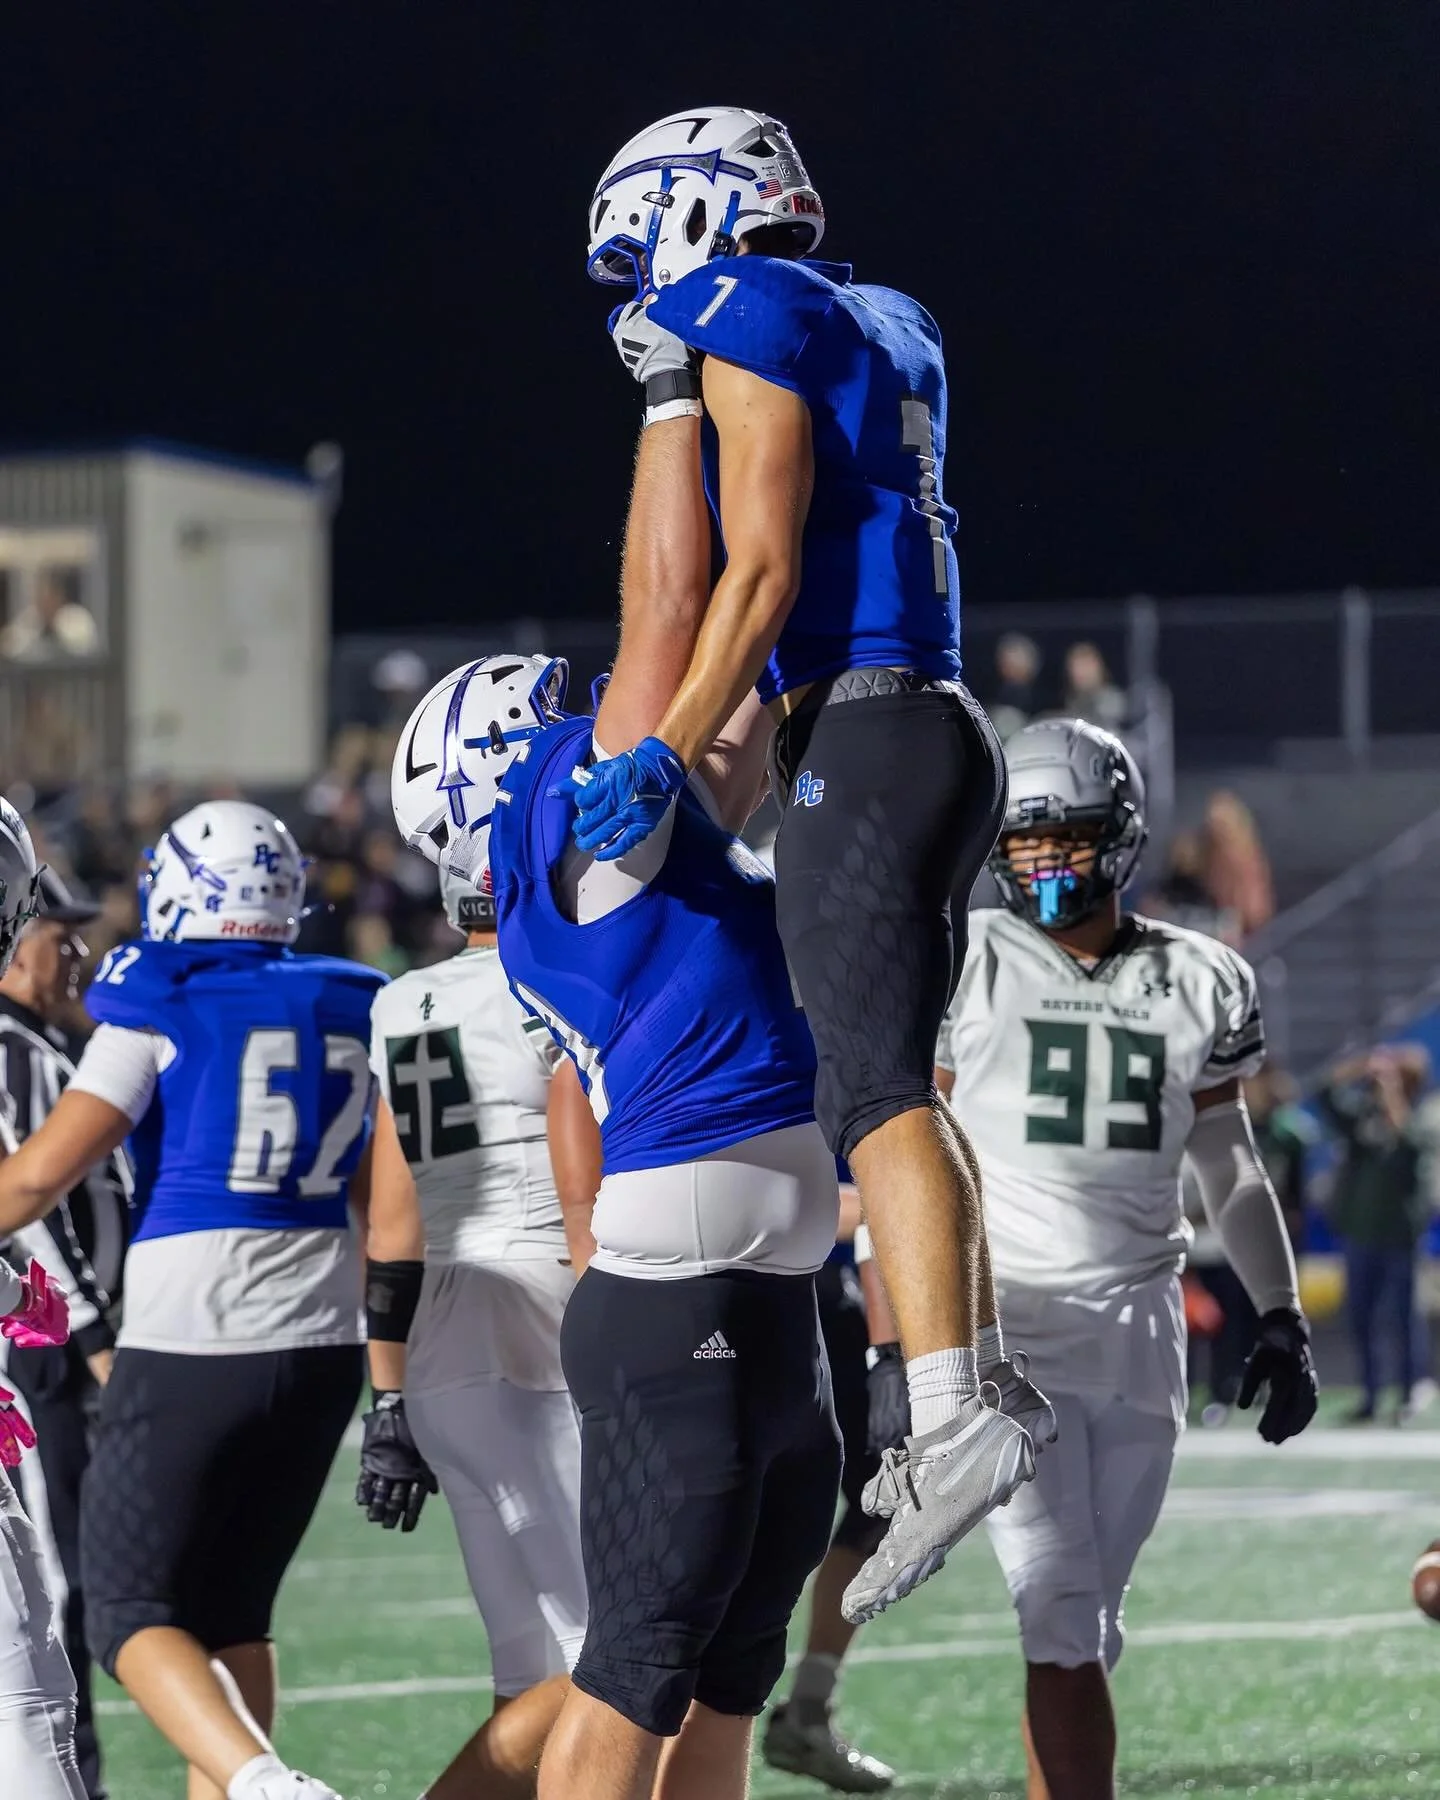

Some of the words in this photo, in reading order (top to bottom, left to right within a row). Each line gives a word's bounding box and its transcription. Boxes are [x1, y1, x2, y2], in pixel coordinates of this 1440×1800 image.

[694, 275, 738, 327] 7
[793, 770, 824, 807] BC
[460, 902, 495, 916] VICI
[1025, 1018, 1167, 1153] 99
[227, 1027, 371, 1196] 62
[693, 1347, 736, 1359] adidas
